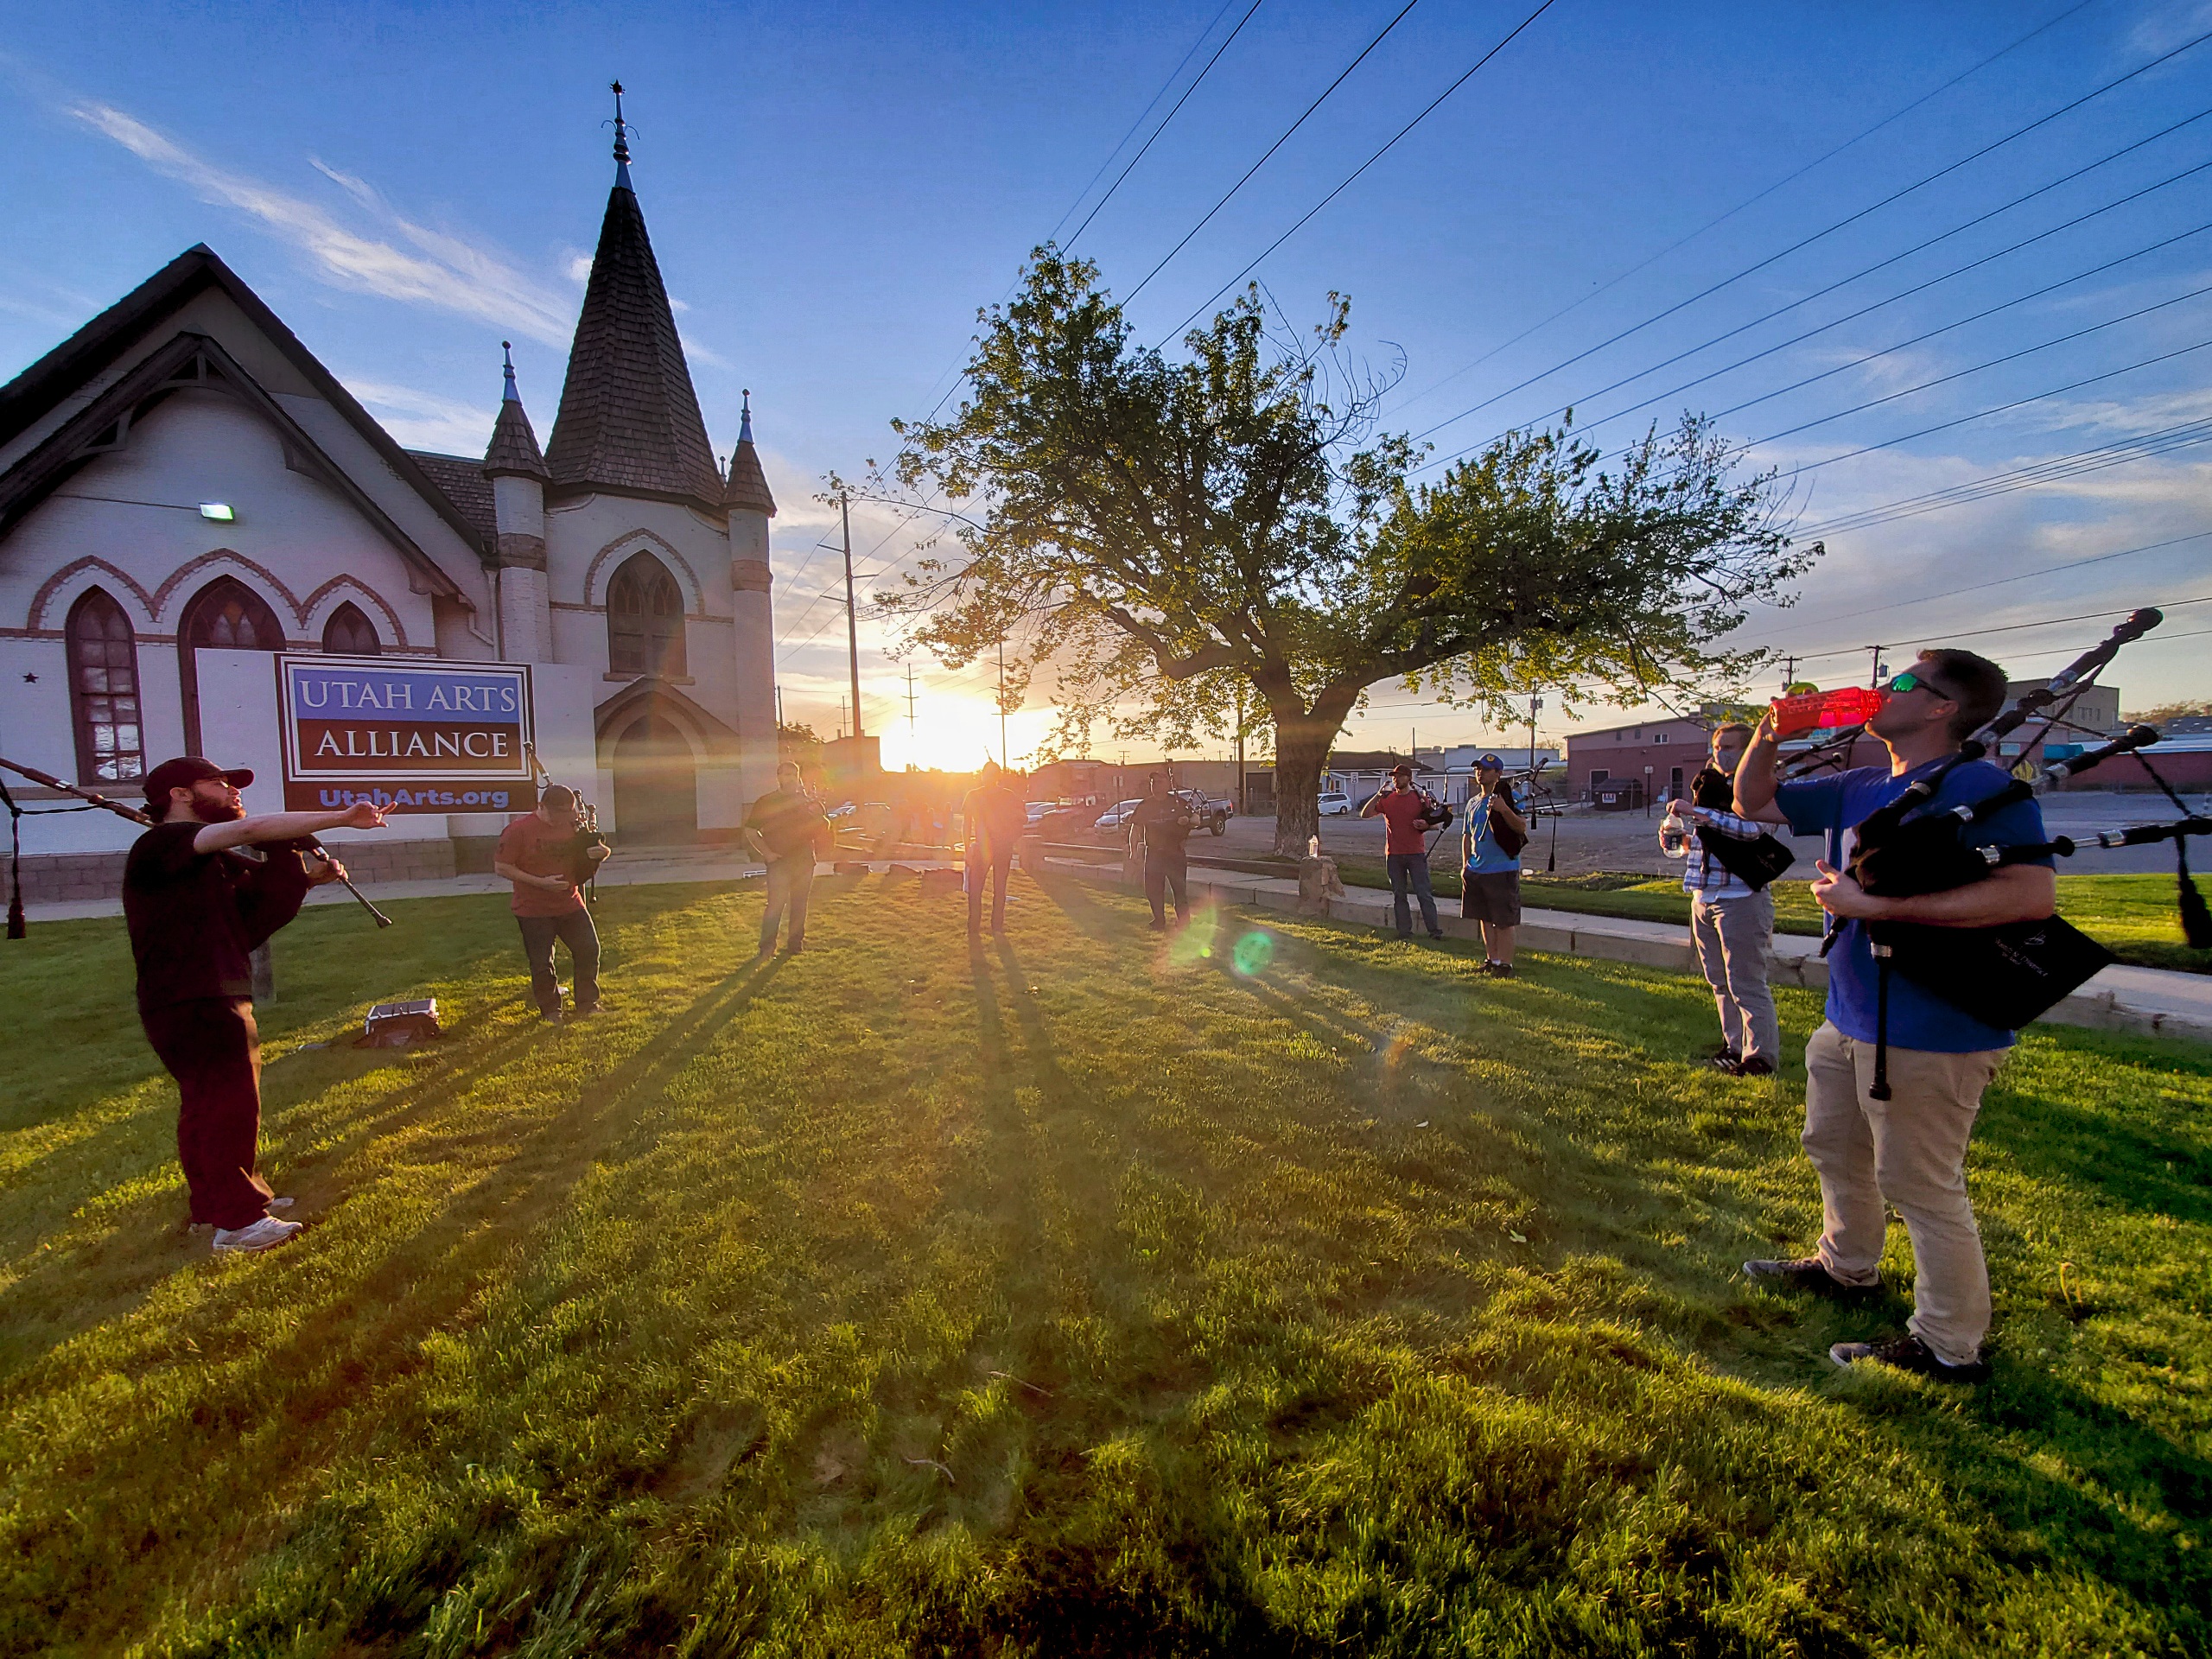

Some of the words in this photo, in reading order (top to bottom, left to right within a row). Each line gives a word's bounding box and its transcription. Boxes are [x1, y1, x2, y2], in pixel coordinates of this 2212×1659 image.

[298, 680, 415, 709] UTAH
[424, 684, 516, 712] ARTS
[314, 729, 509, 758] ALLIANCE
[319, 788, 510, 809] UtahArts.org
